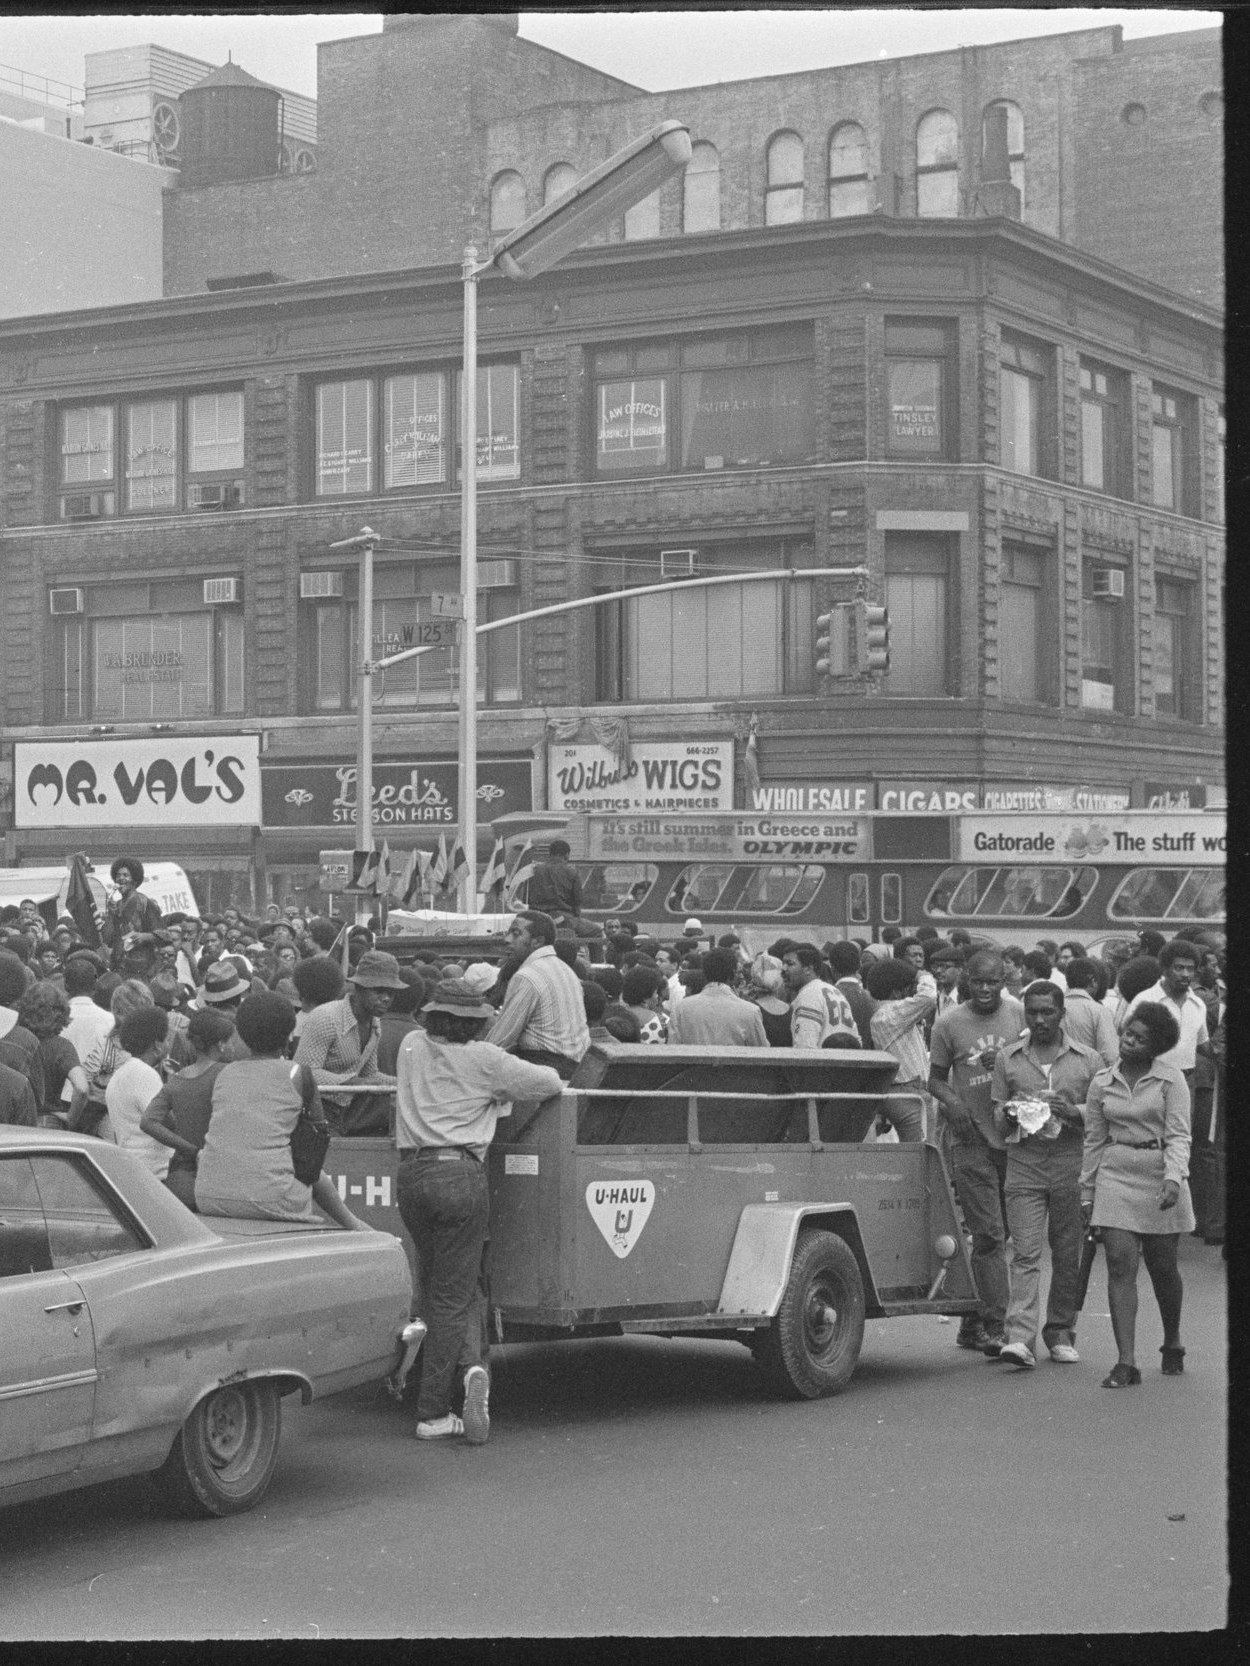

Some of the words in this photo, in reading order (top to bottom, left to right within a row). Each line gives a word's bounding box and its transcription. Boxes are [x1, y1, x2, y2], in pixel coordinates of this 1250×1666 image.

[625, 402, 661, 417] OFFICES
[893, 413, 936, 423] TINSLEY
[896, 425, 934, 436] LAWYER
[437, 596, 445, 612] 7
[403, 625, 414, 643] W
[419, 625, 442, 643] 125
[27, 759, 107, 806] MR.
[113, 749, 245, 806] VAL'S
[642, 759, 721, 790] WIGS
[563, 798, 630, 810] COSMETICS
[645, 797, 719, 809] HAIRPIECES
[882, 790, 976, 811] CIGARS
[332, 808, 406, 823] STESON
[411, 807, 453, 822] HATS
[603, 820, 625, 836] It's
[628, 820, 660, 836] still
[664, 822, 734, 836] summer
[738, 821, 755, 836] in
[758, 820, 819, 837] Greece
[823, 820, 858, 837] and
[602, 838, 628, 853] the
[633, 837, 684, 853] Greek
[743, 841, 857, 855] OLYMPIC
[974, 832, 1055, 851] Gatorade
[1113, 831, 1146, 851] The
[1152, 831, 1197, 851] stuff
[161, 891, 190, 912] TAKE
[595, 1187, 646, 1205] U-HAUL
